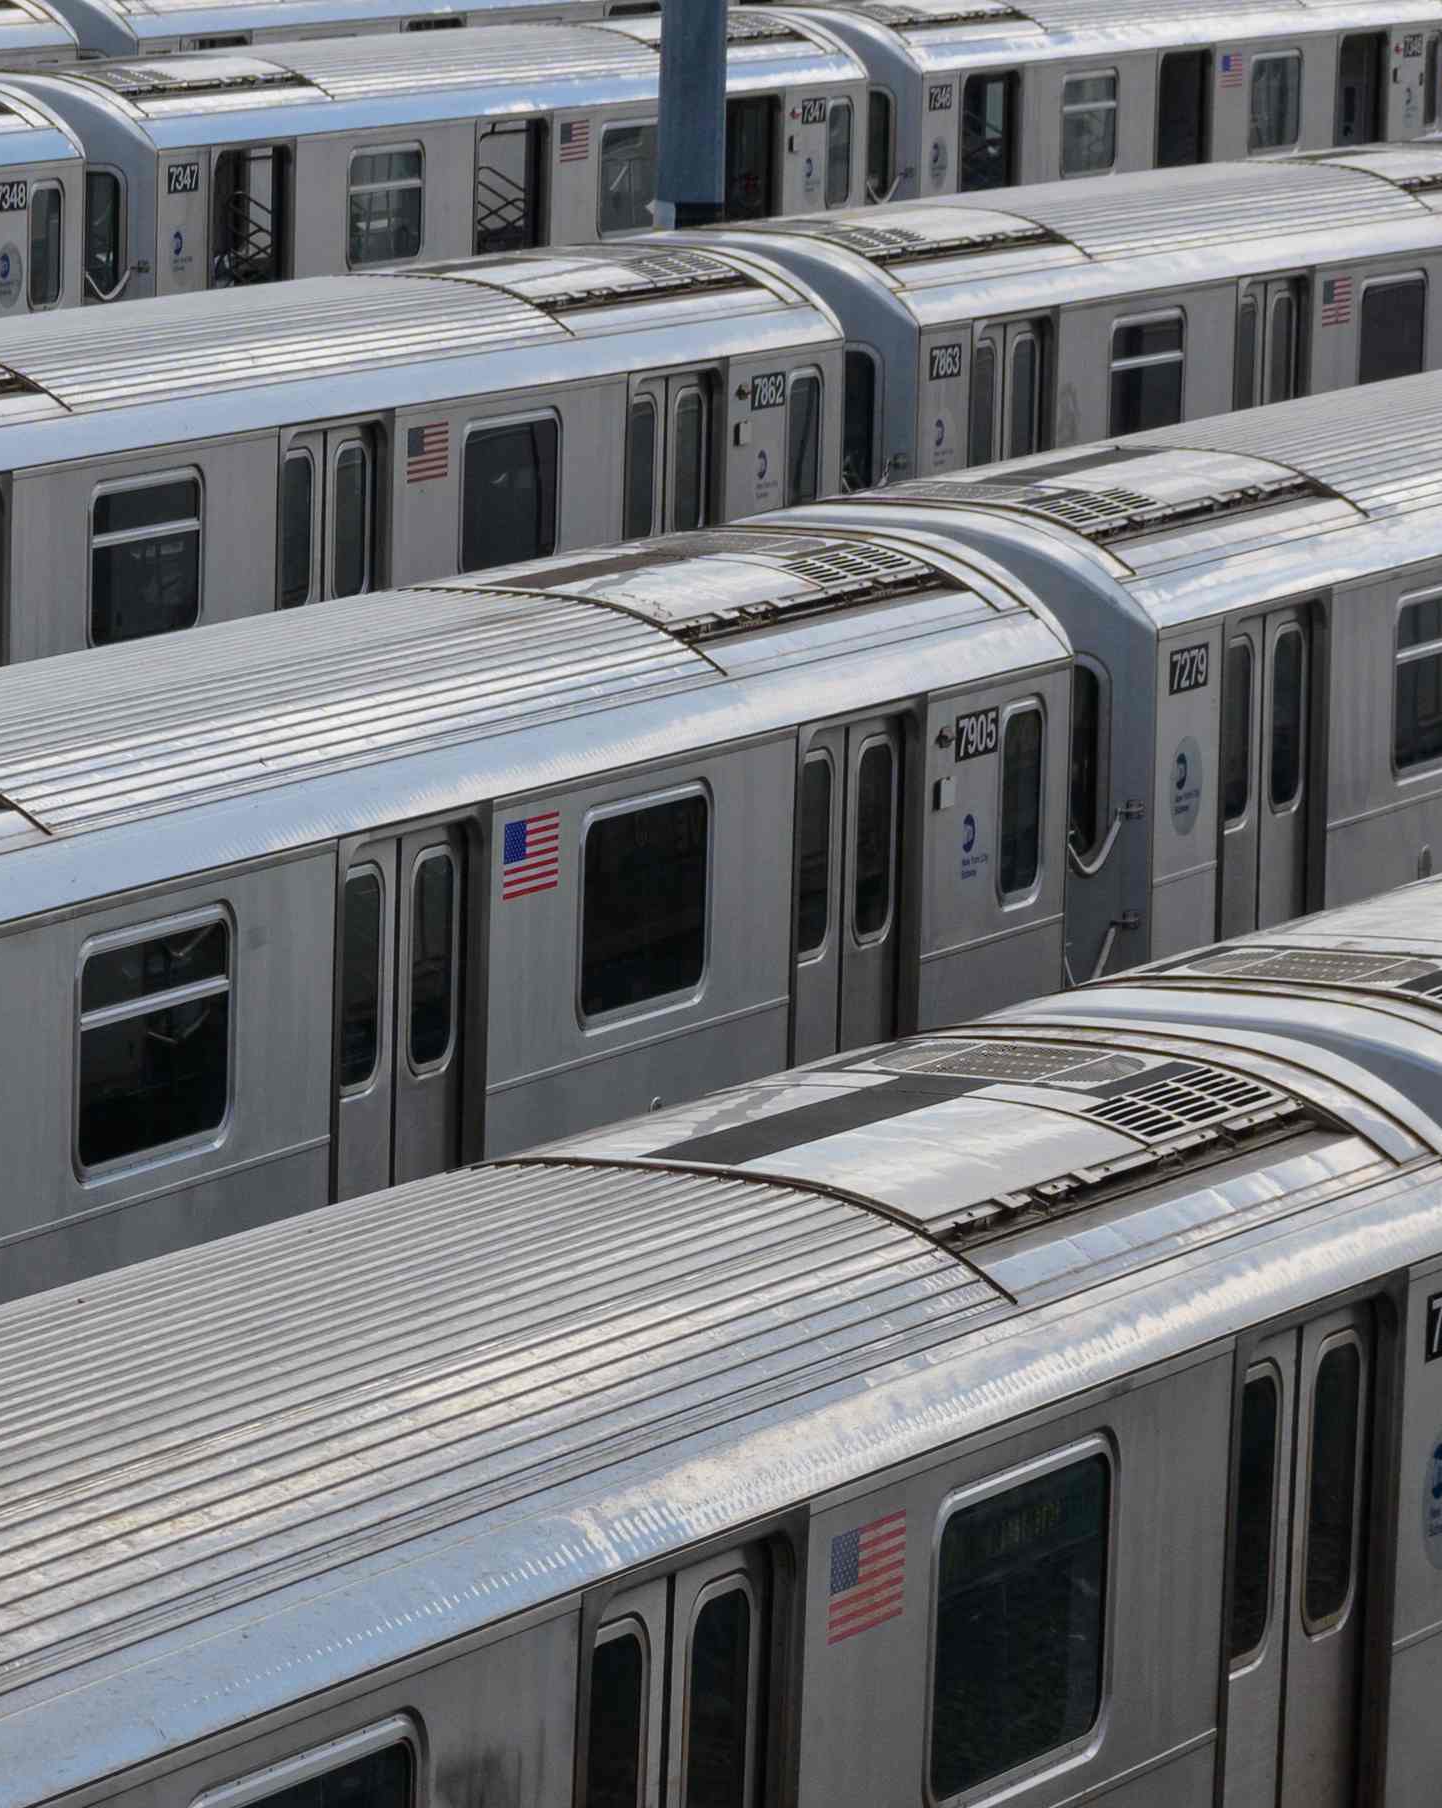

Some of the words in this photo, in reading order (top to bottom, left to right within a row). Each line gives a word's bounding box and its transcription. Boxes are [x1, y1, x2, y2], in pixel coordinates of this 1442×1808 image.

[169, 165, 198, 193] 7347
[932, 347, 960, 379] 7863
[754, 375, 783, 408] 7862
[1173, 645, 1206, 692] 7279
[958, 711, 996, 758] 7905
